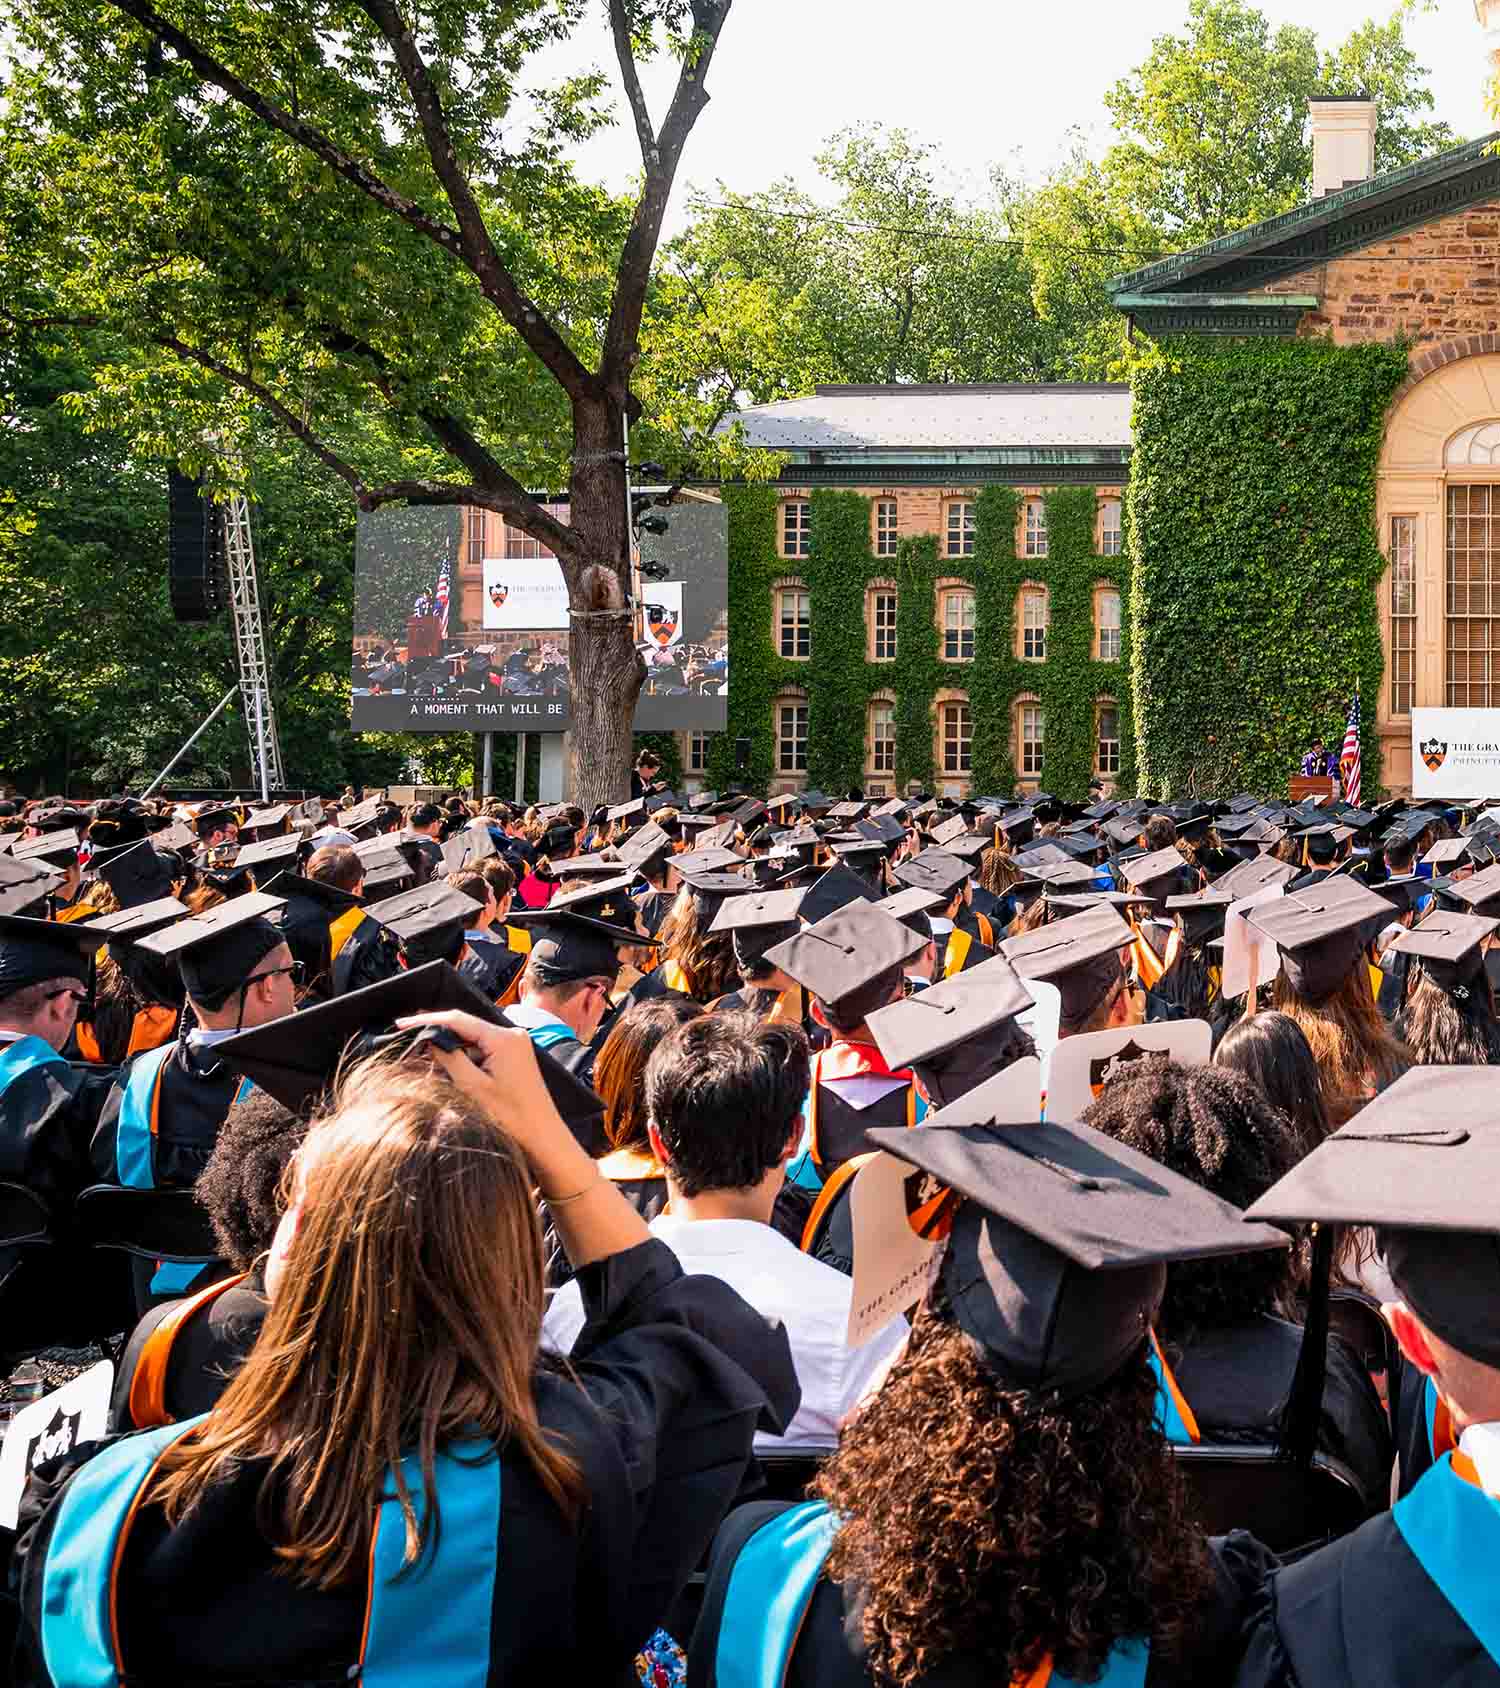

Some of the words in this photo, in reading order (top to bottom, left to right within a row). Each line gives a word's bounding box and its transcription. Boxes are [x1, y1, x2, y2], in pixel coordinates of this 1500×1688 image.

[410, 704, 418, 714] A
[425, 704, 468, 714] MOMENT
[476, 704, 505, 714] THAT
[511, 704, 540, 714] WILL
[548, 704, 562, 714] BE
[1451, 743, 1475, 752] THE
